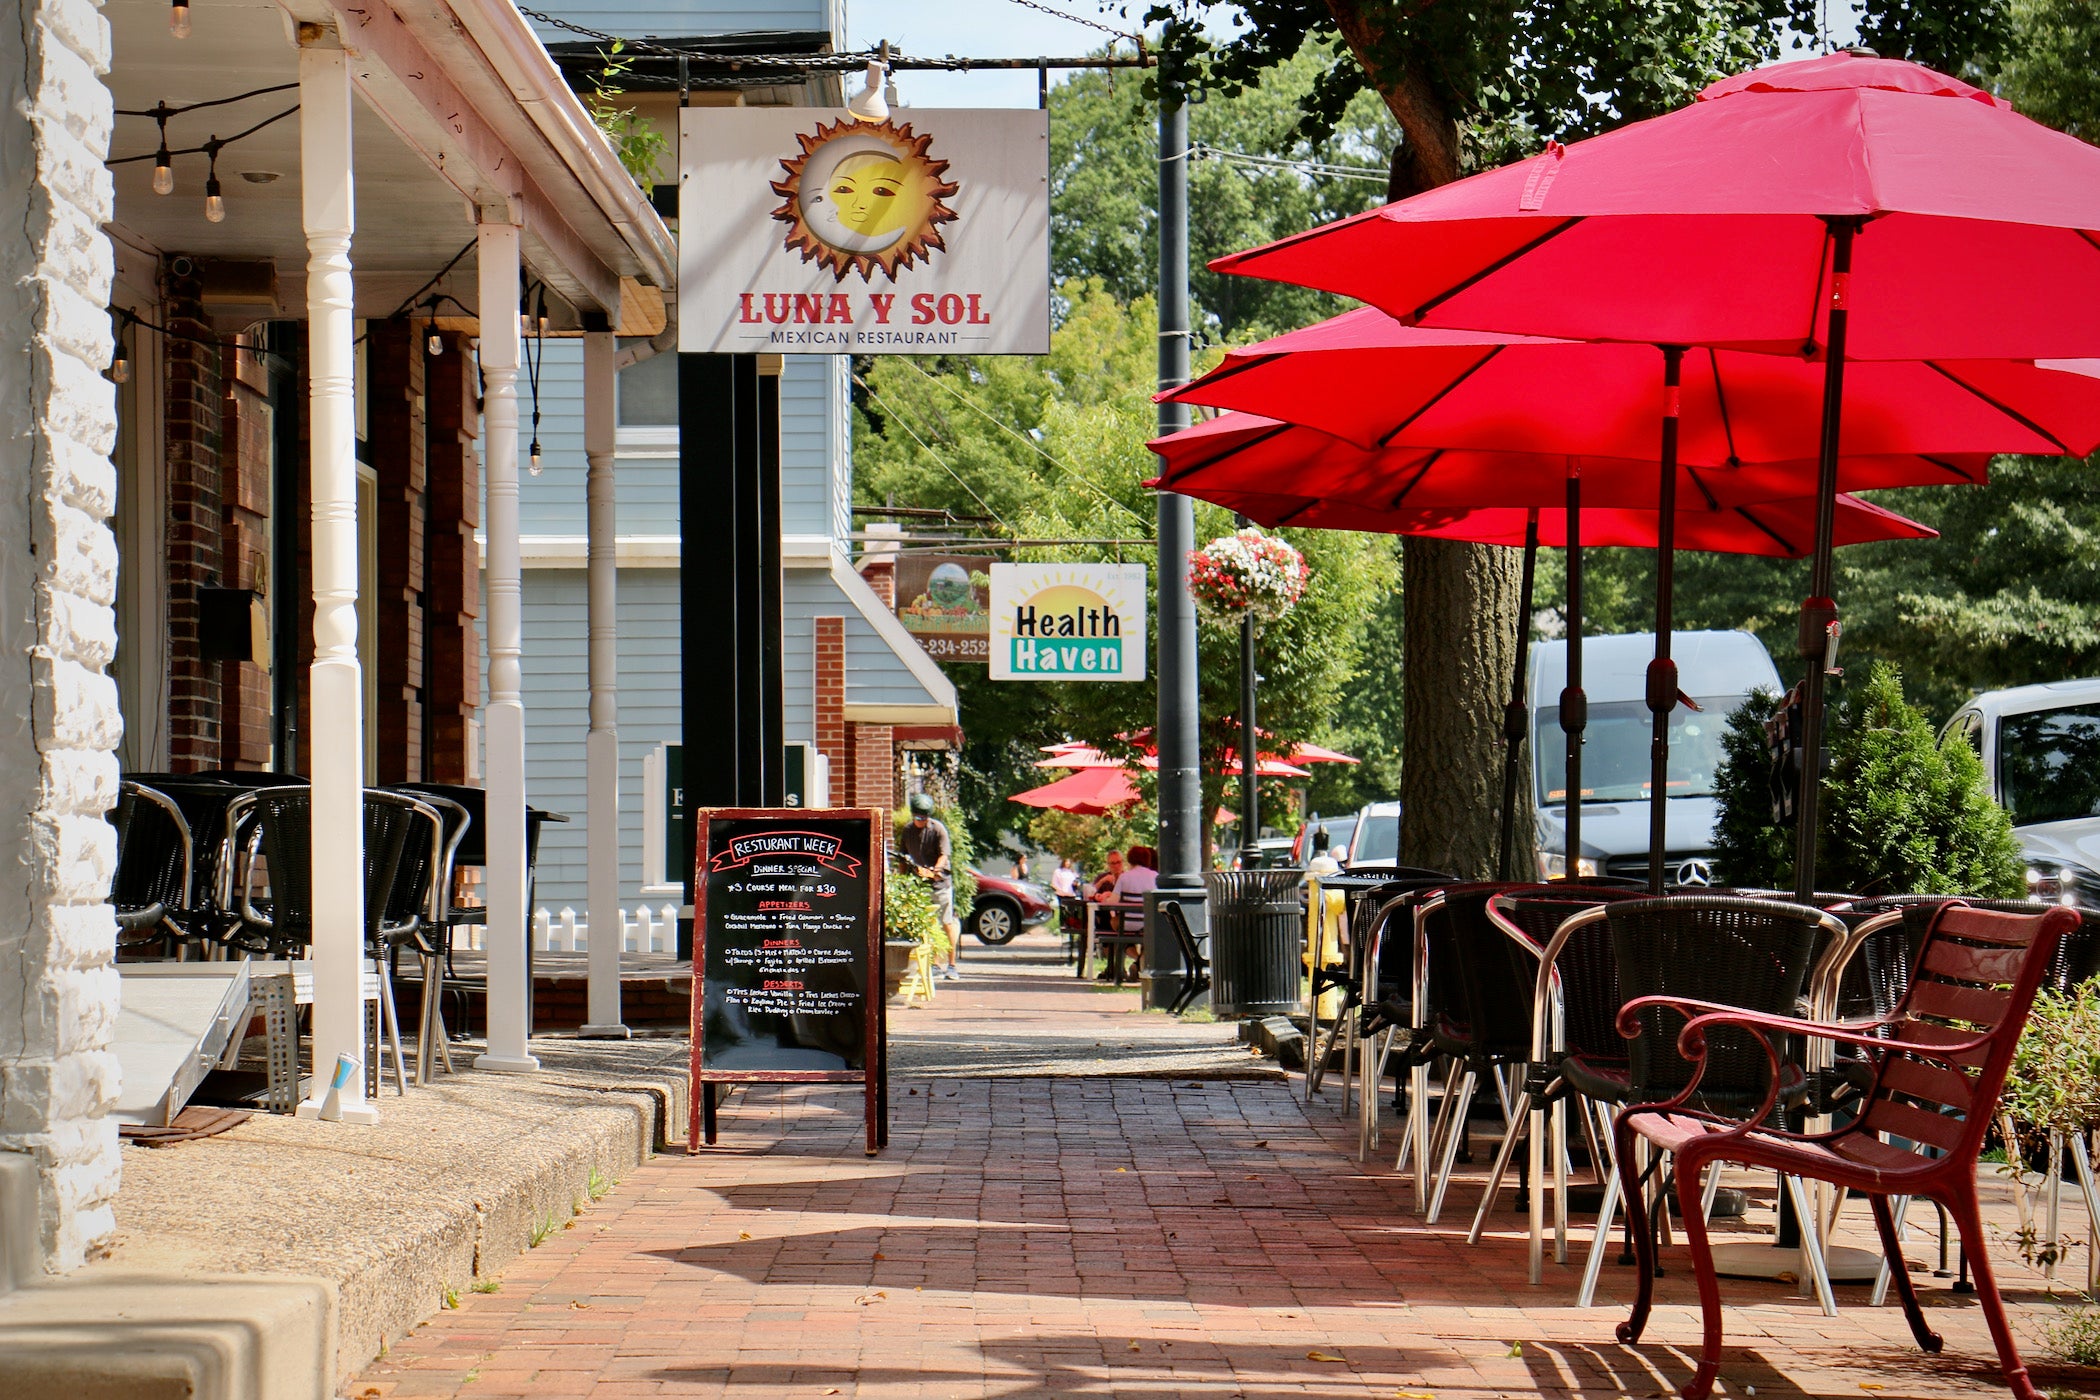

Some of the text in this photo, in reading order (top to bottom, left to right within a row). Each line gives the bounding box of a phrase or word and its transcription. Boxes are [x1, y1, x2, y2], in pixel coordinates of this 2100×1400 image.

[739, 293, 990, 324] LUNA Y SOL
[771, 331, 957, 344] MEXICAN RESTAURANT
[1017, 606, 1119, 637] Health
[1016, 640, 1119, 671] Haven
[734, 837, 836, 856] RESTURANT WEEK
[746, 884, 775, 892] COURSE
[817, 884, 836, 893] $30
[779, 913, 796, 921] Fried
[764, 980, 803, 988] DESSERTS
